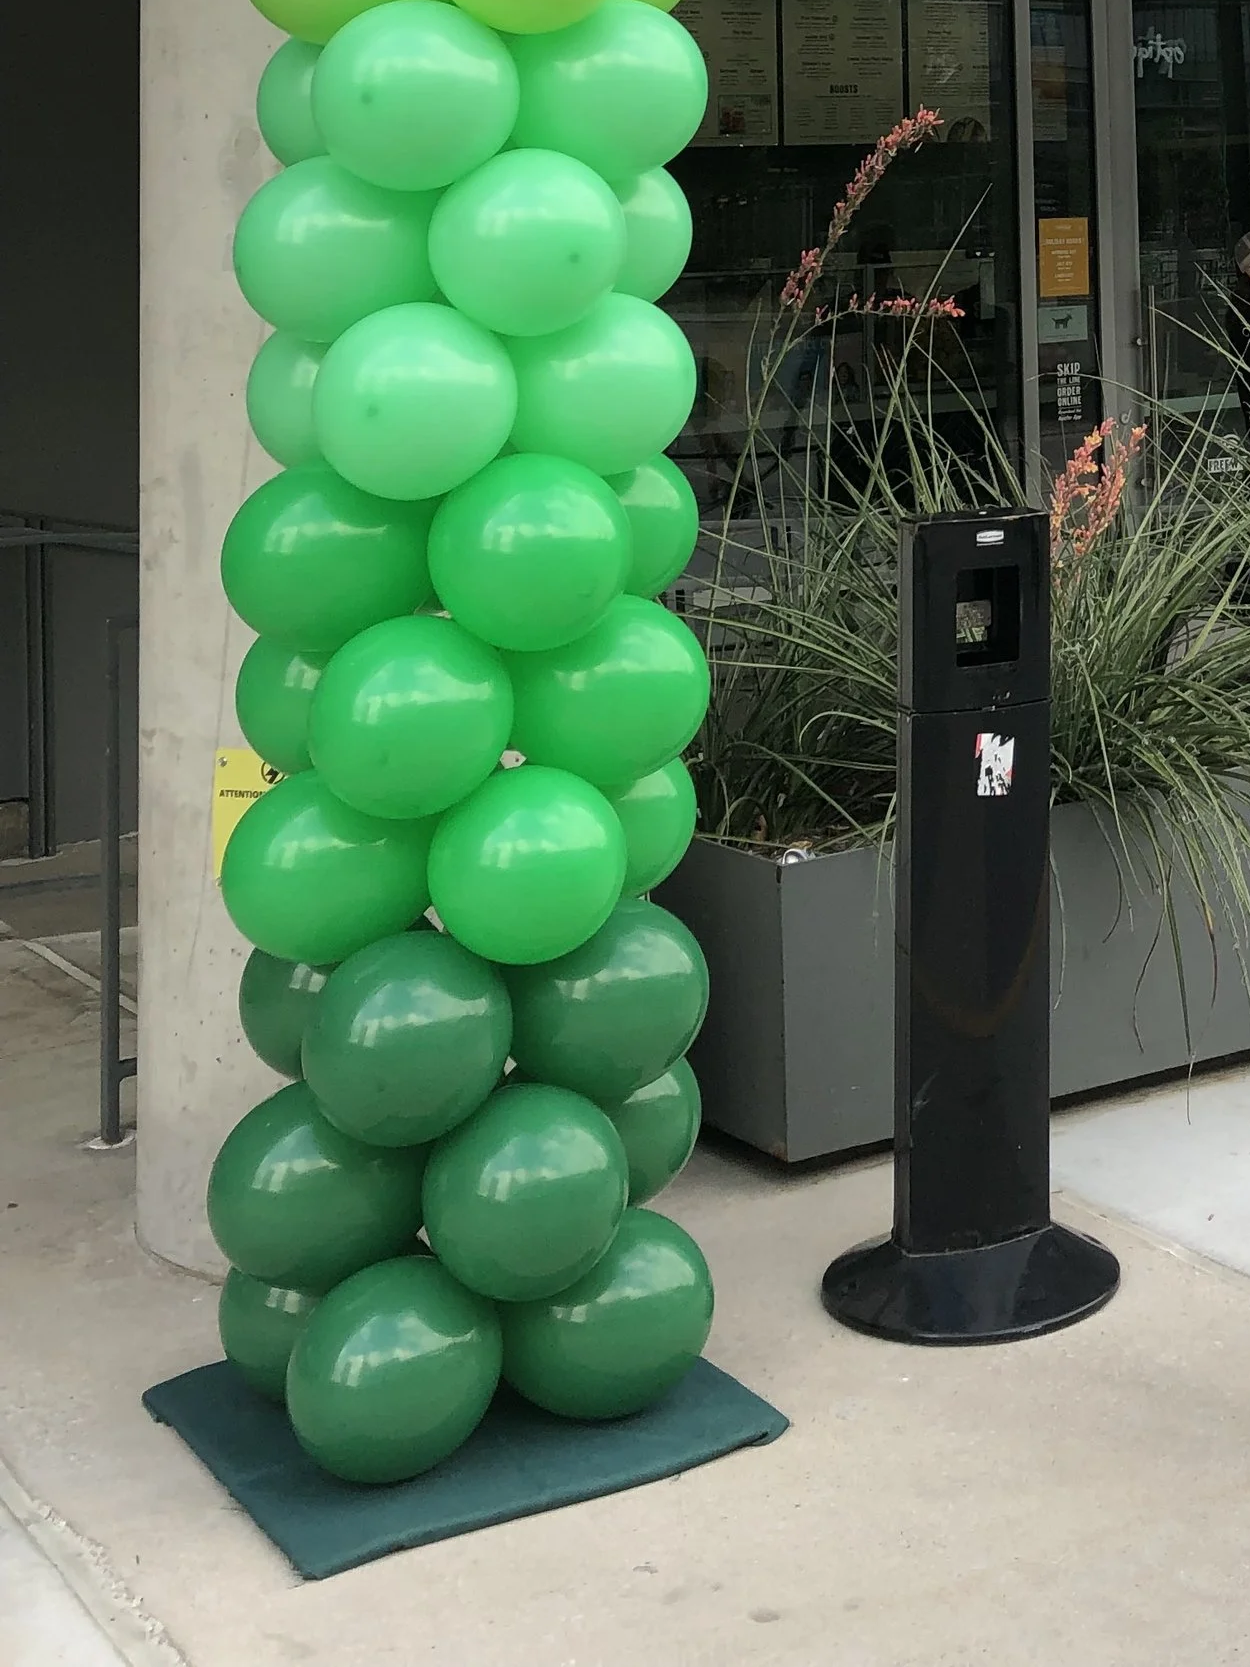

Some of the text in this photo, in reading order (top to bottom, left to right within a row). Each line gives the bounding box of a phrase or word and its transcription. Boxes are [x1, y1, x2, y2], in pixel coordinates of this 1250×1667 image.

[1057, 362, 1081, 377] SKIP
[1057, 386, 1081, 397] ORDER
[1057, 396, 1082, 407] ONLINE
[219, 789, 266, 799] ATTENTIO
